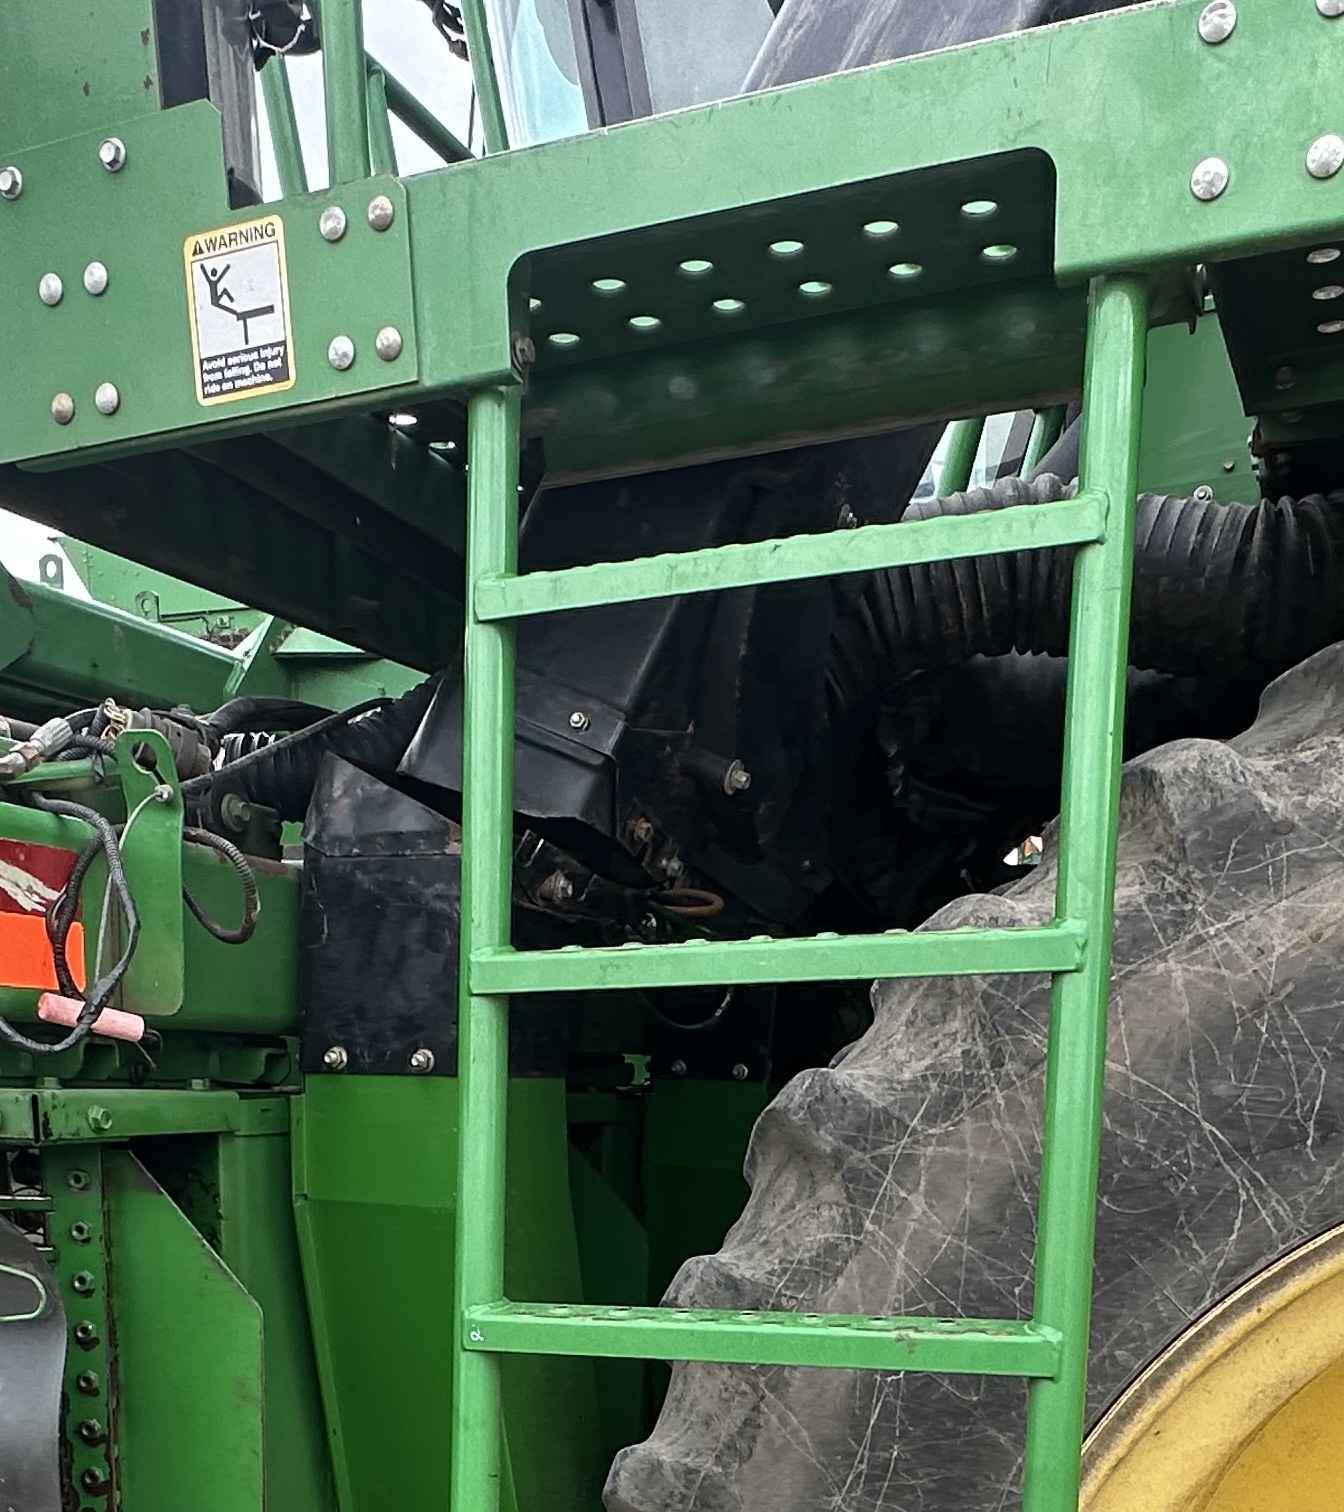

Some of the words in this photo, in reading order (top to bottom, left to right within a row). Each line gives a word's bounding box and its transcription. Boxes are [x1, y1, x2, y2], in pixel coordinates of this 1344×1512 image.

[204, 222, 276, 253] WARNING
[203, 356, 225, 370] Avoid
[228, 350, 259, 365] serious
[260, 344, 285, 360] injury
[204, 382, 220, 394] ride
[222, 380, 233, 390] on
